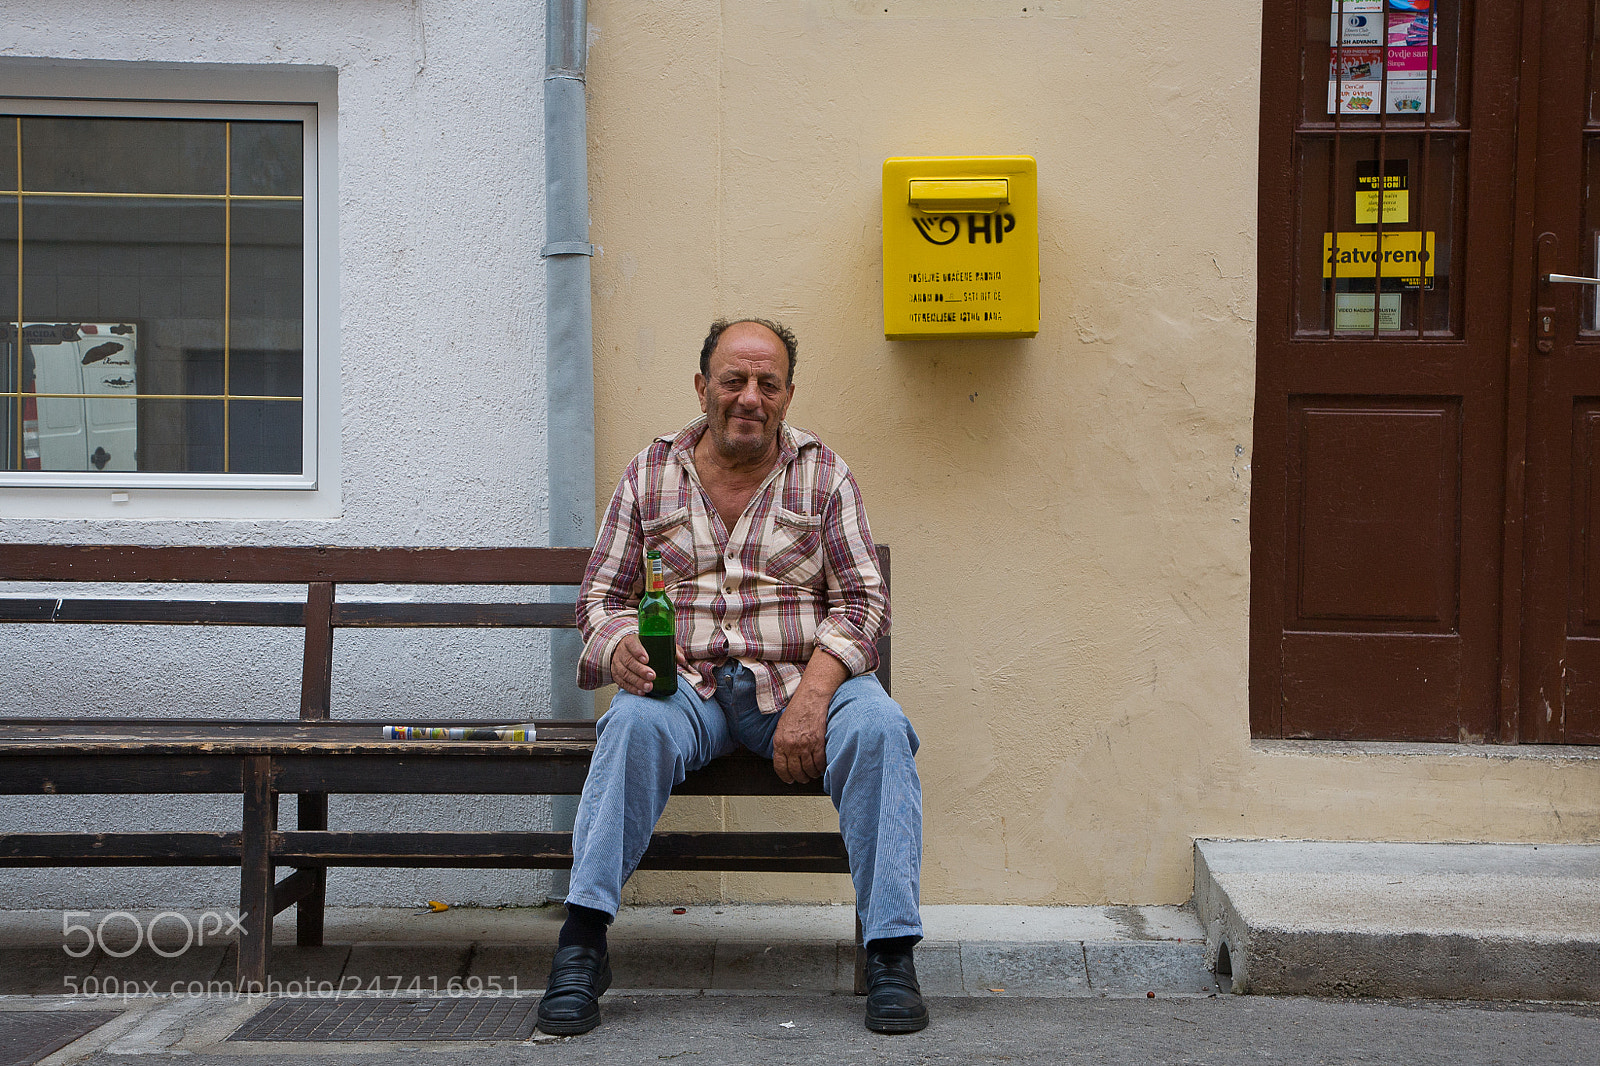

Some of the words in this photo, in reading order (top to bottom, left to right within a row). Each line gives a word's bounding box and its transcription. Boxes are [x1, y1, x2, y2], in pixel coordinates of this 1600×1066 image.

[1388, 49, 1411, 59] Ovdje
[968, 213, 1015, 244] HP
[1327, 248, 1430, 264] Zatvoreno
